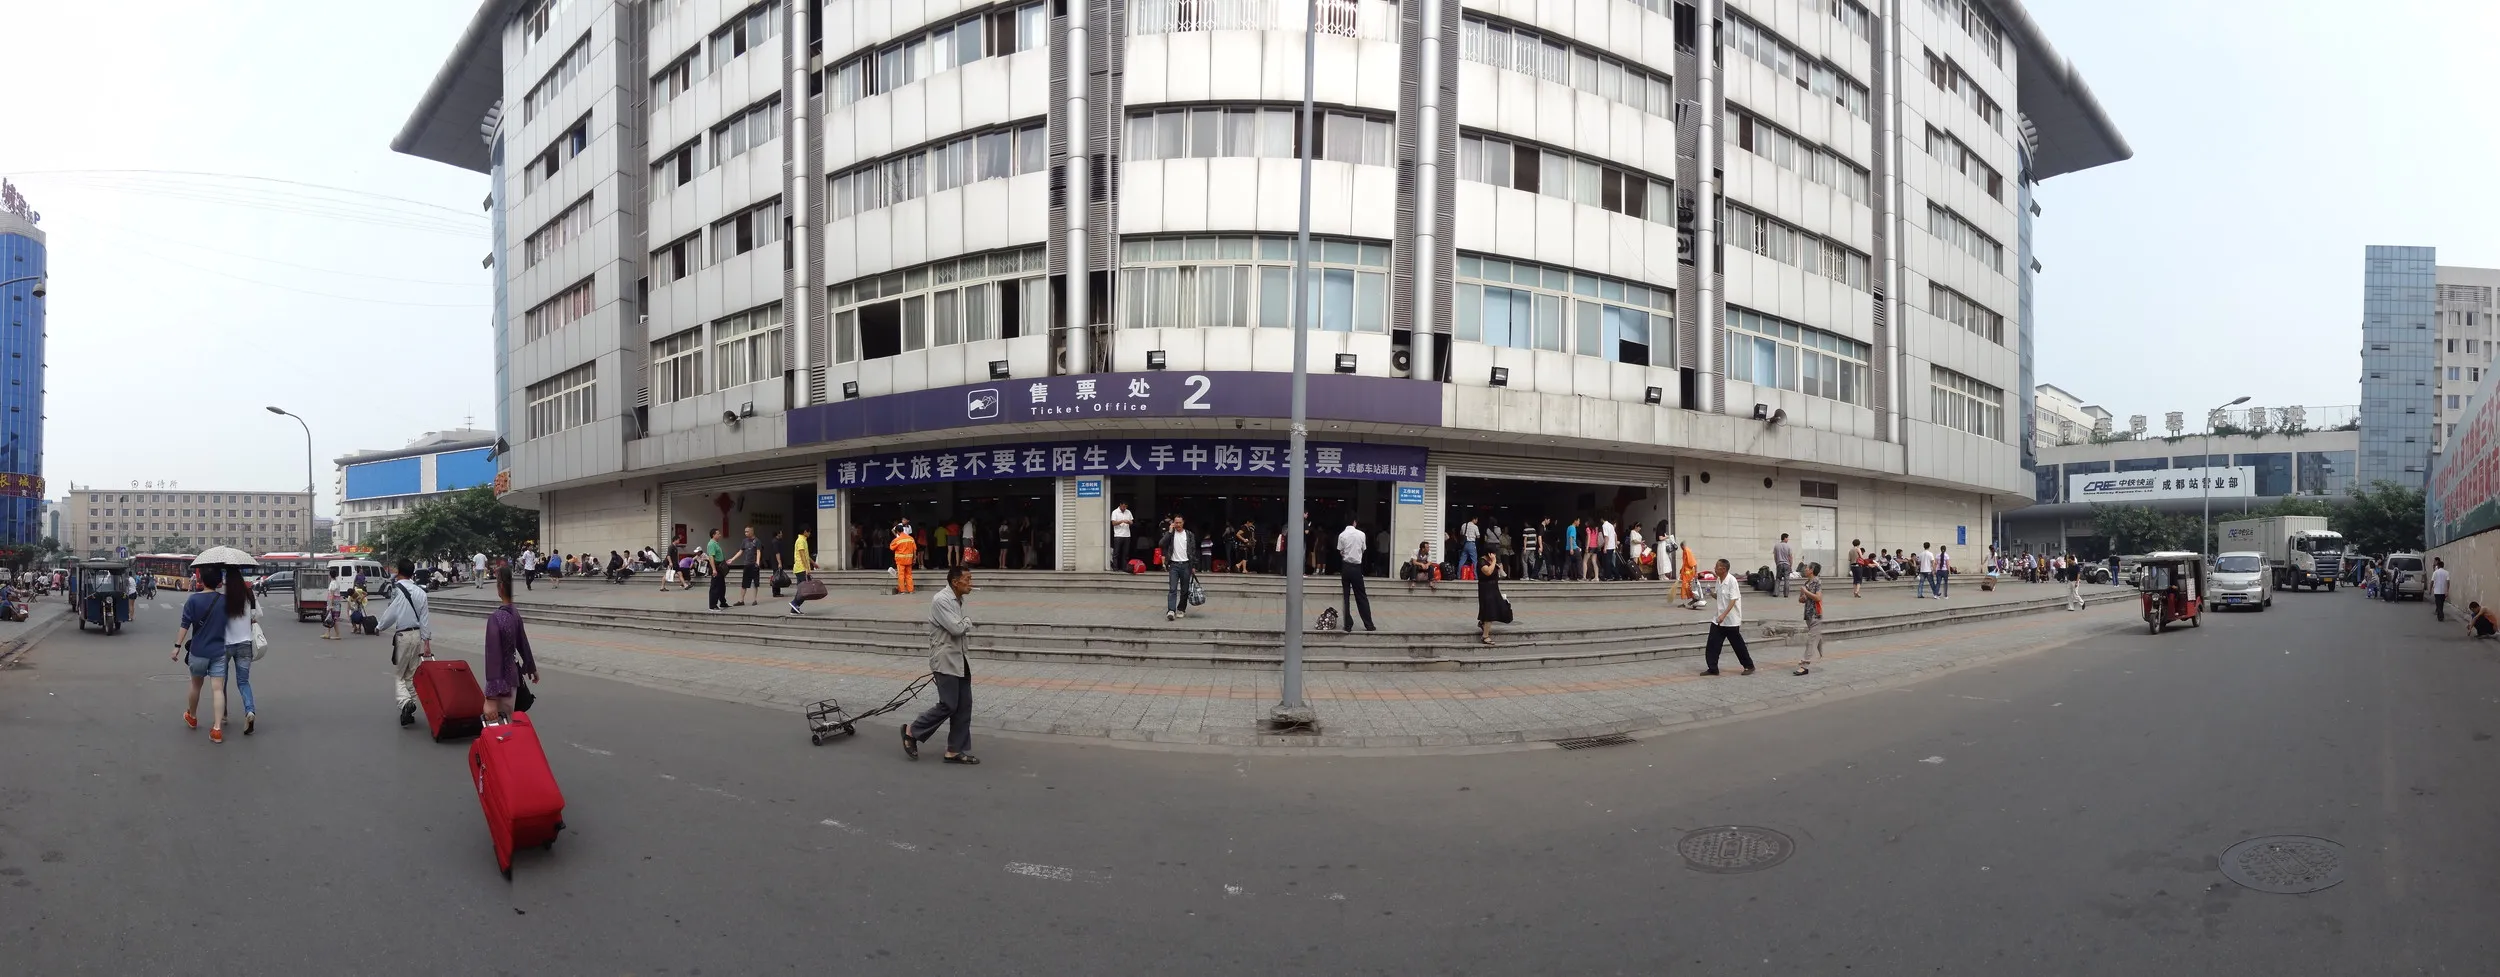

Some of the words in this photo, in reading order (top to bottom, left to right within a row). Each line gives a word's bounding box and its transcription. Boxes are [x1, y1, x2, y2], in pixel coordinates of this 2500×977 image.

[1029, 378, 1150, 403] 售票处
[1183, 375, 1211, 410] 2
[1031, 405, 1080, 415] Ticket
[1093, 403, 1147, 412] Office
[1347, 463, 1407, 476] 成都车站派出所
[2162, 477, 2239, 491] 成都站营业部
